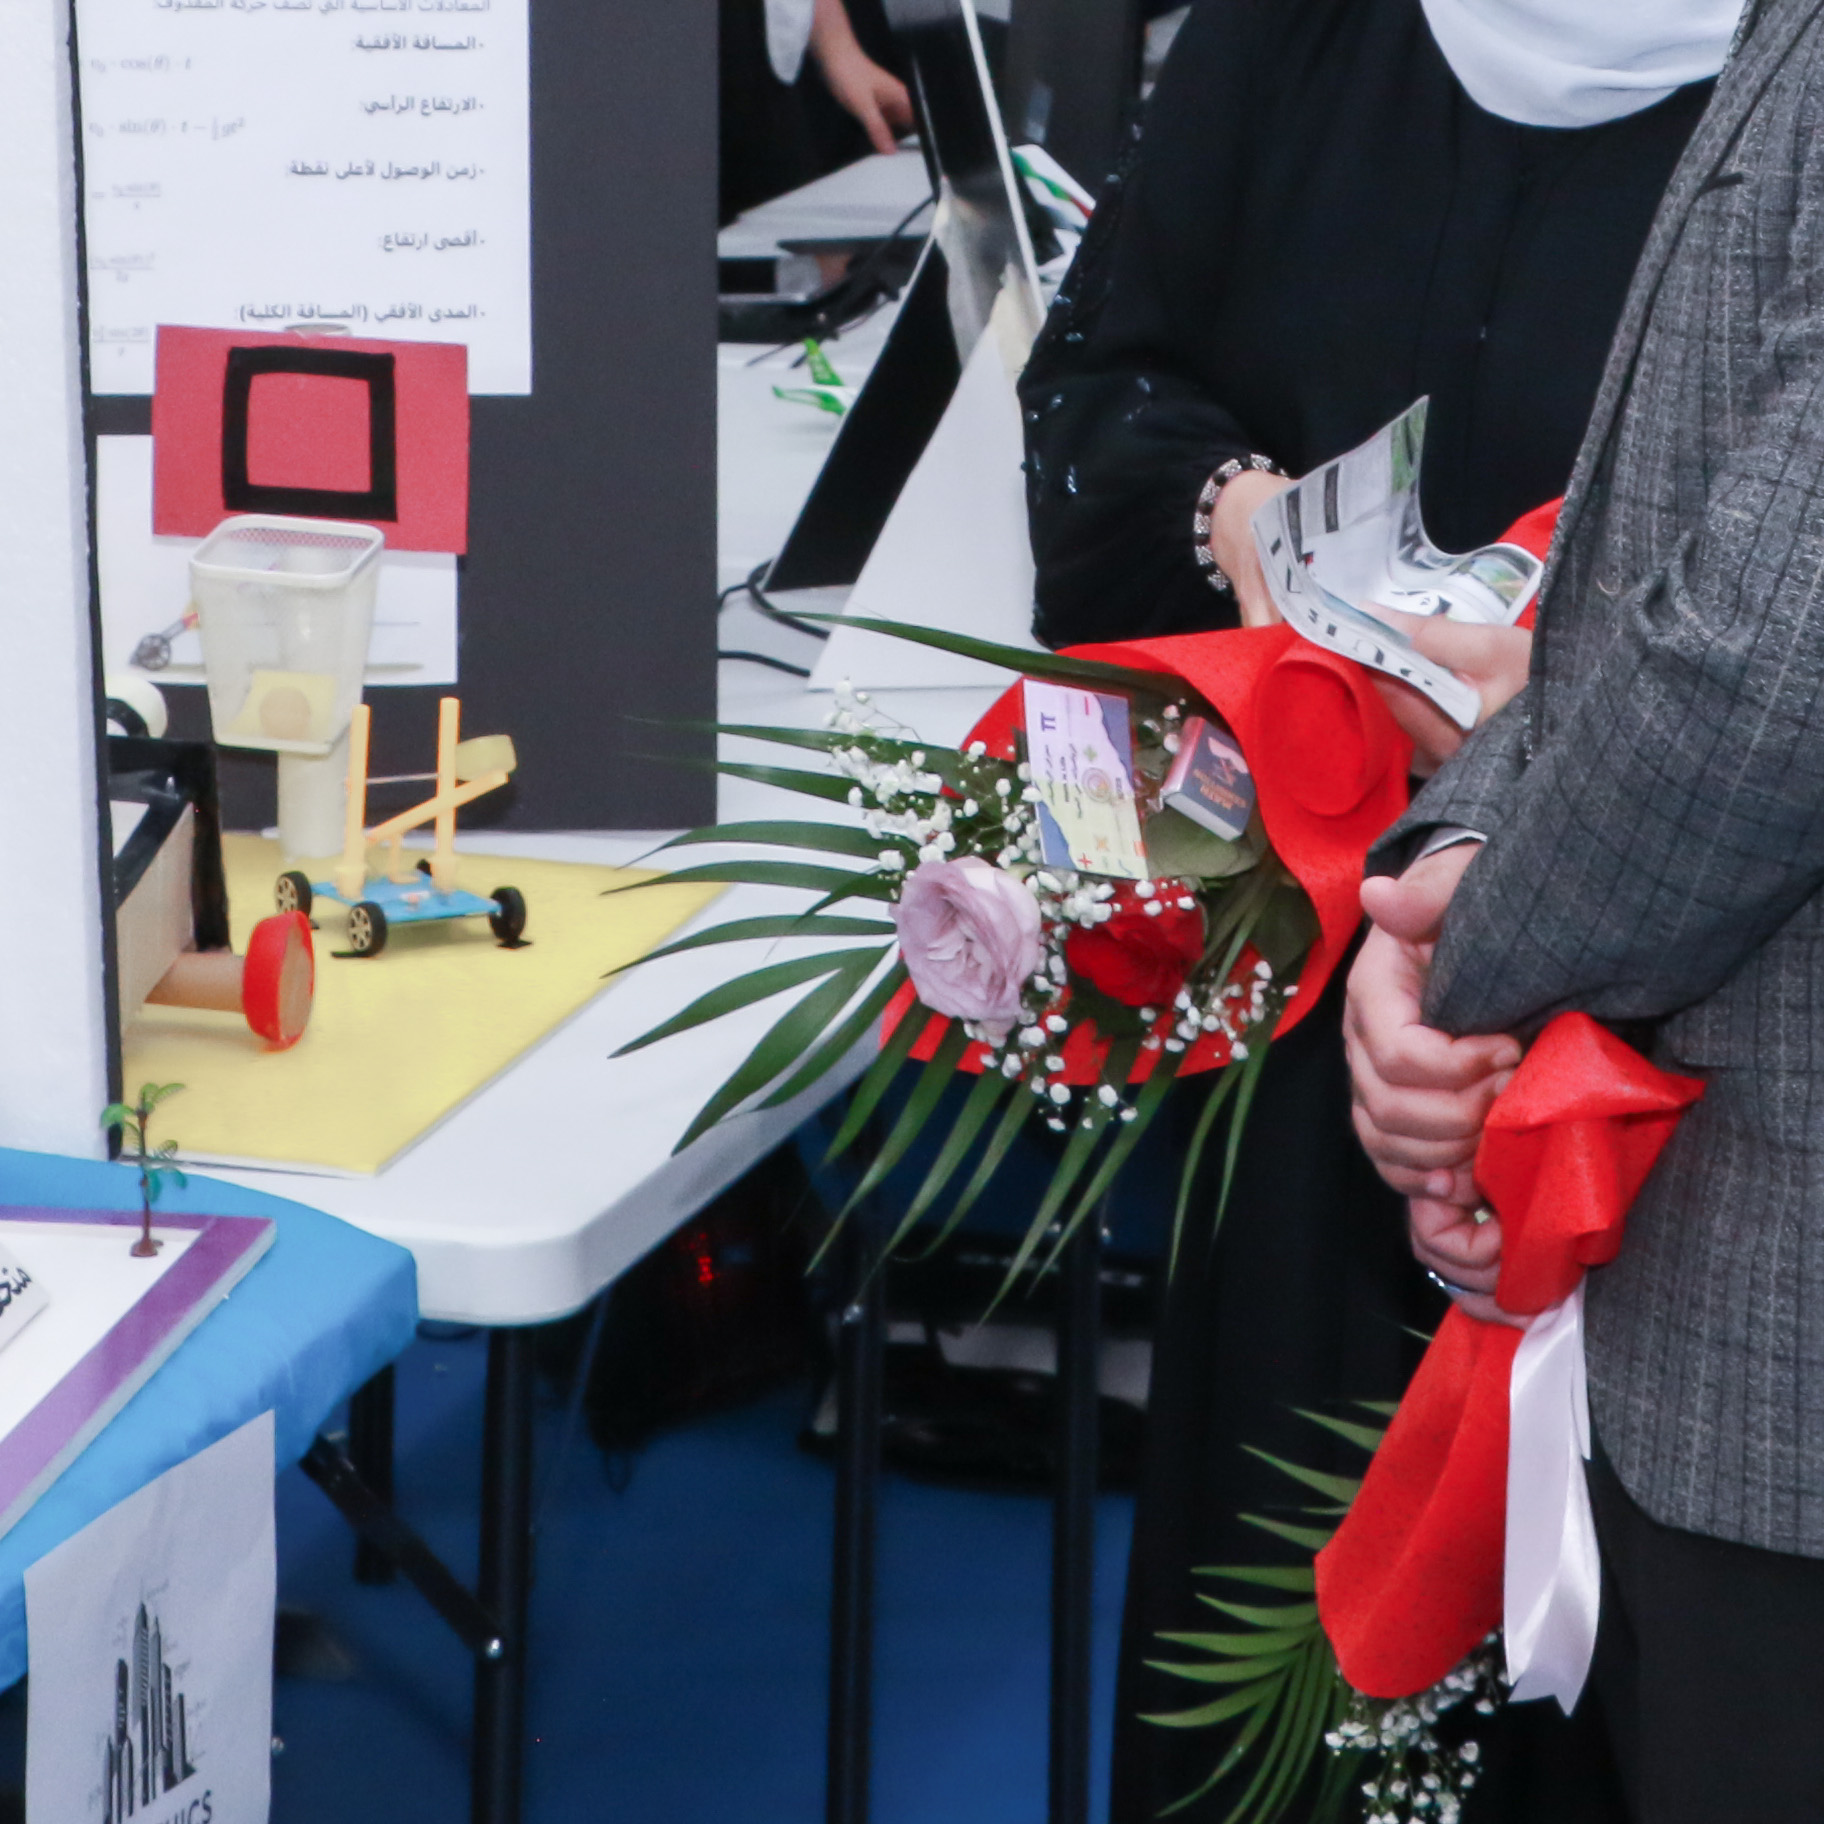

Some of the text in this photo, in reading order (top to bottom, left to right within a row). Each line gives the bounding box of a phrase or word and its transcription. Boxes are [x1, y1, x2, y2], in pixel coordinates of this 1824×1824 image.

[335, 159, 376, 181] لأعلى
[380, 161, 441, 181] الوصول
[433, 229, 478, 252] أقصى
[428, 303, 478, 323] المدى
